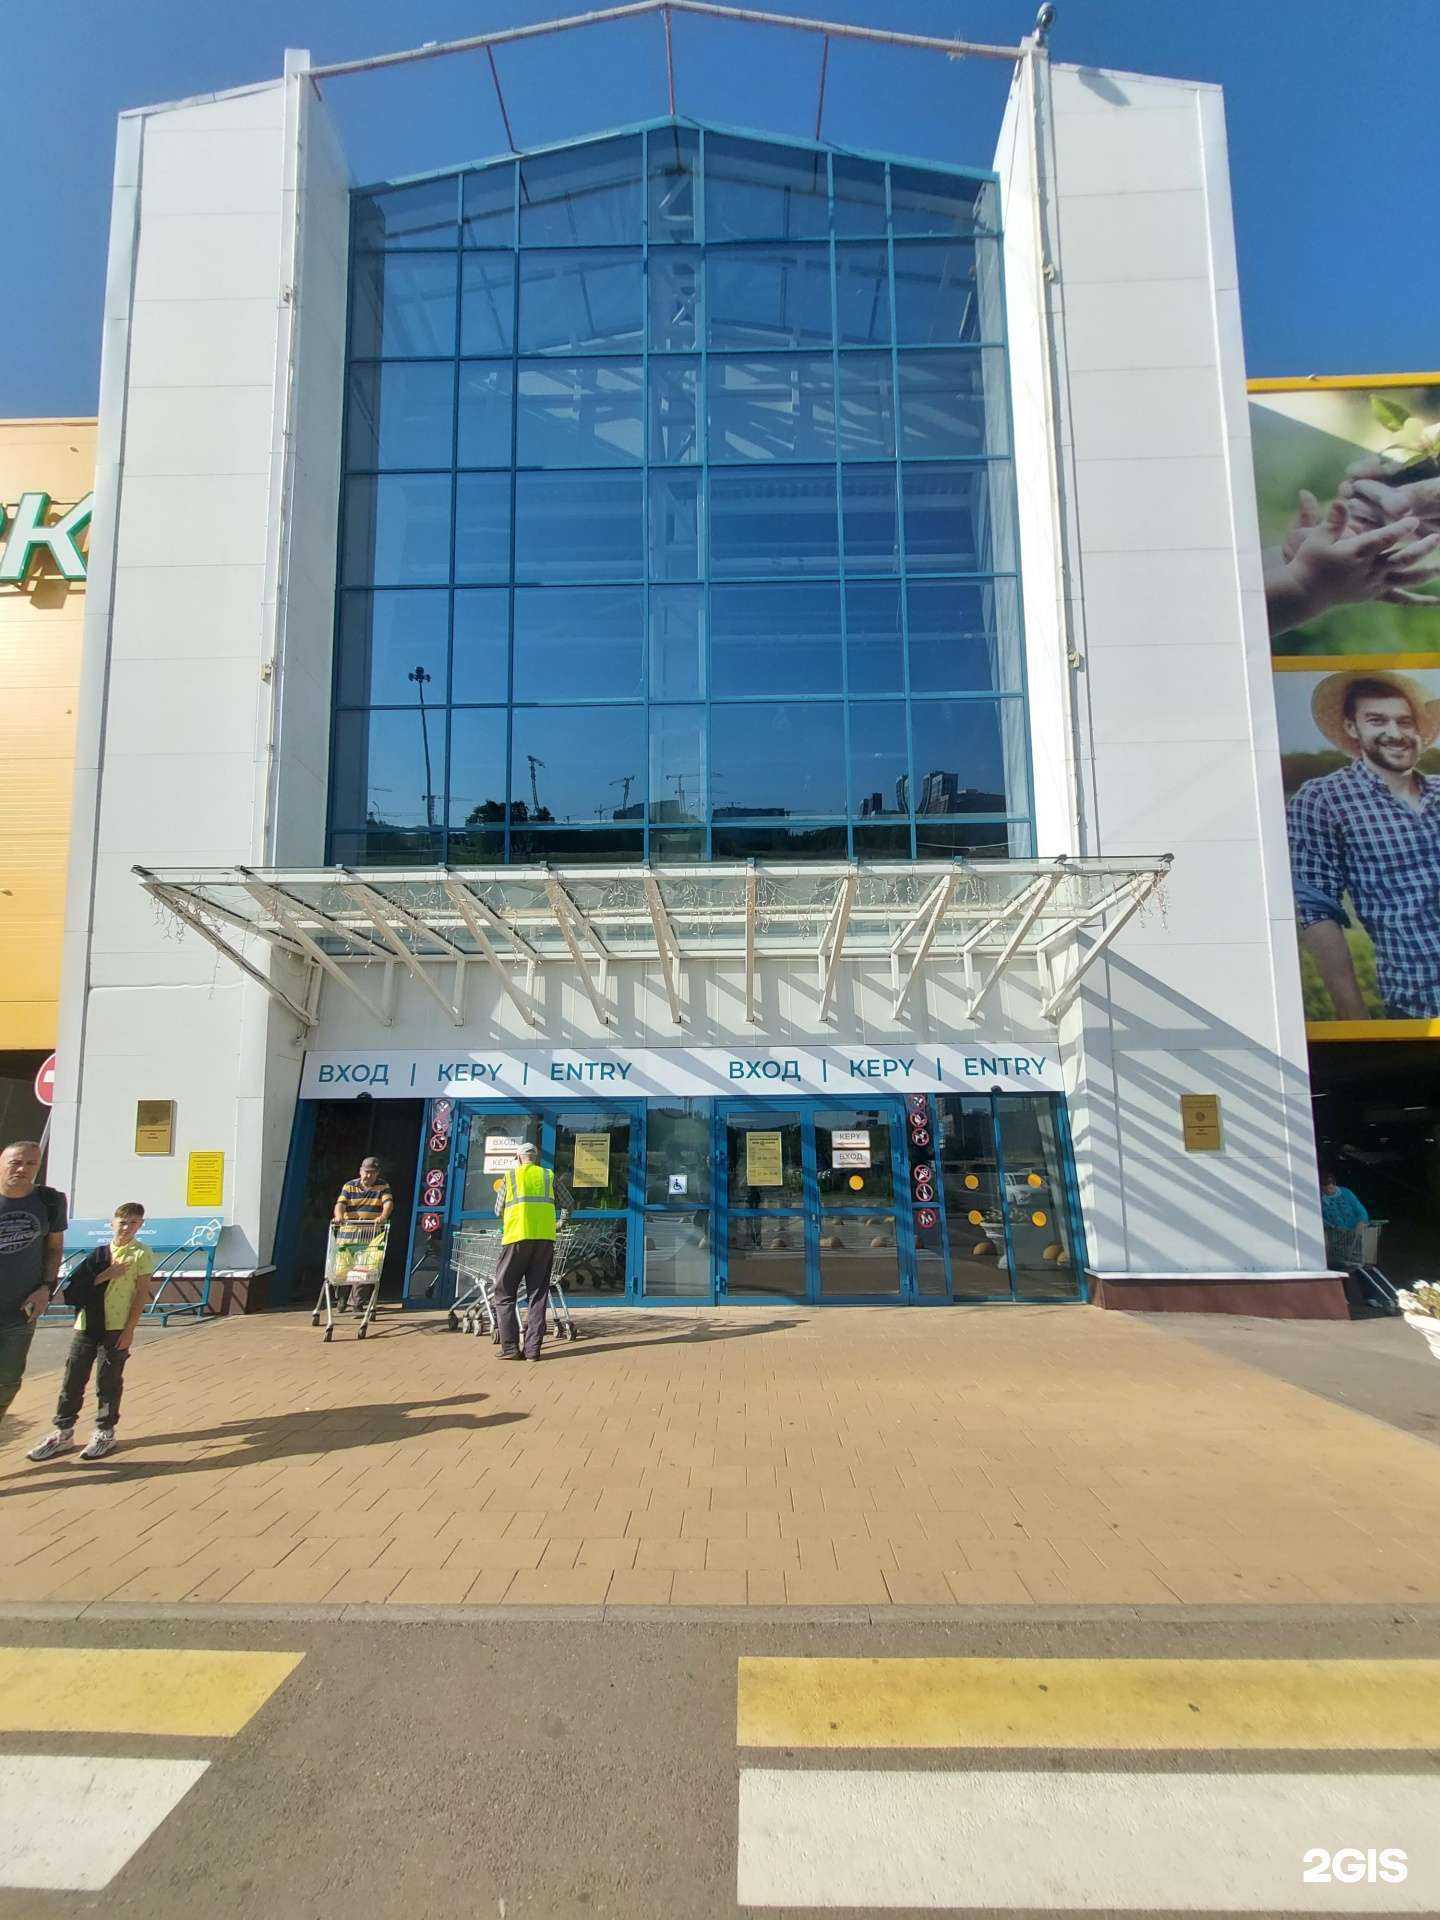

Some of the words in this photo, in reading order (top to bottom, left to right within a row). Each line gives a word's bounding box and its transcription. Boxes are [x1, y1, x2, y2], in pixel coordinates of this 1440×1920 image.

[318, 1064, 390, 1086] ВХОД
[550, 1062, 632, 1081] ENTRY
[728, 1060, 801, 1082] ВХОД
[964, 1057, 1046, 1076] ENTRY
[839, 1153, 863, 1161] ВХОД
